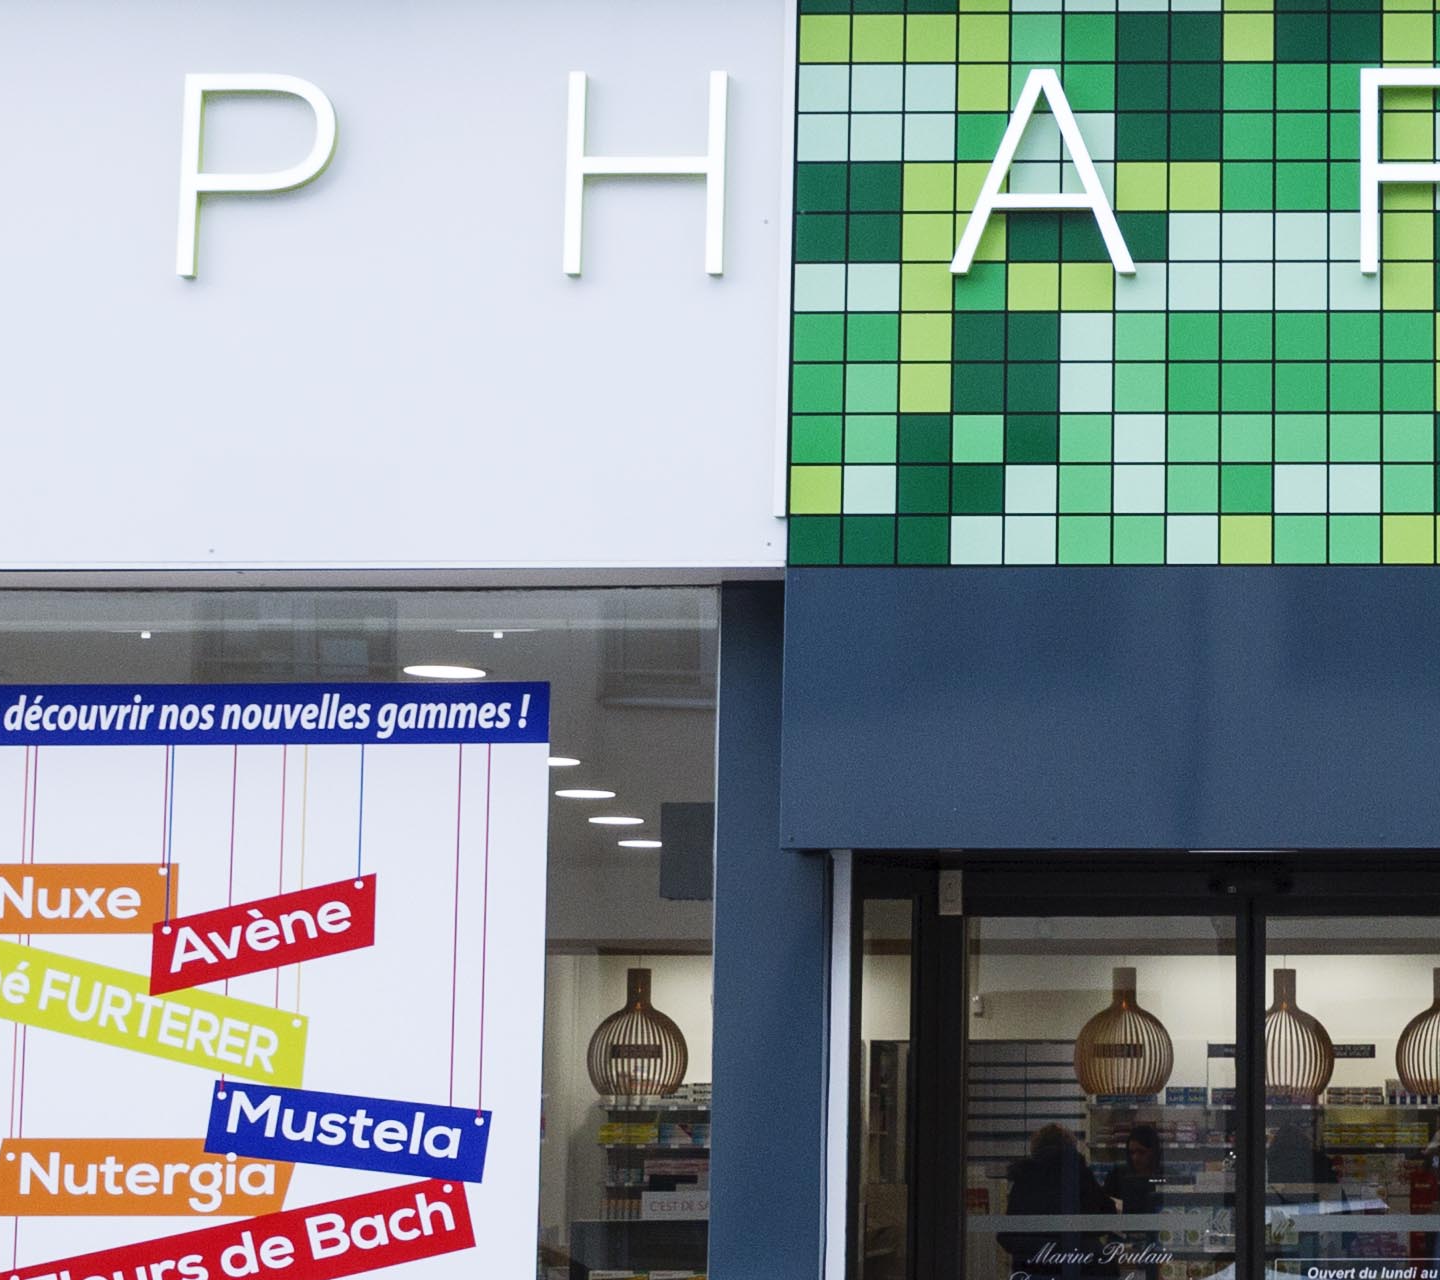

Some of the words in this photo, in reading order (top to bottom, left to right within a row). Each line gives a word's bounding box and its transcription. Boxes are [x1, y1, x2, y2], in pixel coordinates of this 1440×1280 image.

[3, 694, 155, 733] découvrir
[159, 701, 216, 732] nos
[222, 694, 373, 732] nouvelles
[376, 699, 512, 739] gammes
[168, 898, 354, 974] Avène
[37, 969, 281, 1074] FURTERER
[225, 1088, 463, 1160] Mustela
[19, 1150, 277, 1212] Nutergia
[221, 1229, 295, 1280] de
[305, 1200, 457, 1261] Bach
[1026, 1241, 1093, 1266] Marine
[1097, 1241, 1175, 1266] Poulain
[1307, 1266, 1355, 1280] Ouvert
[1359, 1266, 1376, 1280] du
[1380, 1266, 1417, 1280] lundi
[1420, 1268, 1438, 1280] au
